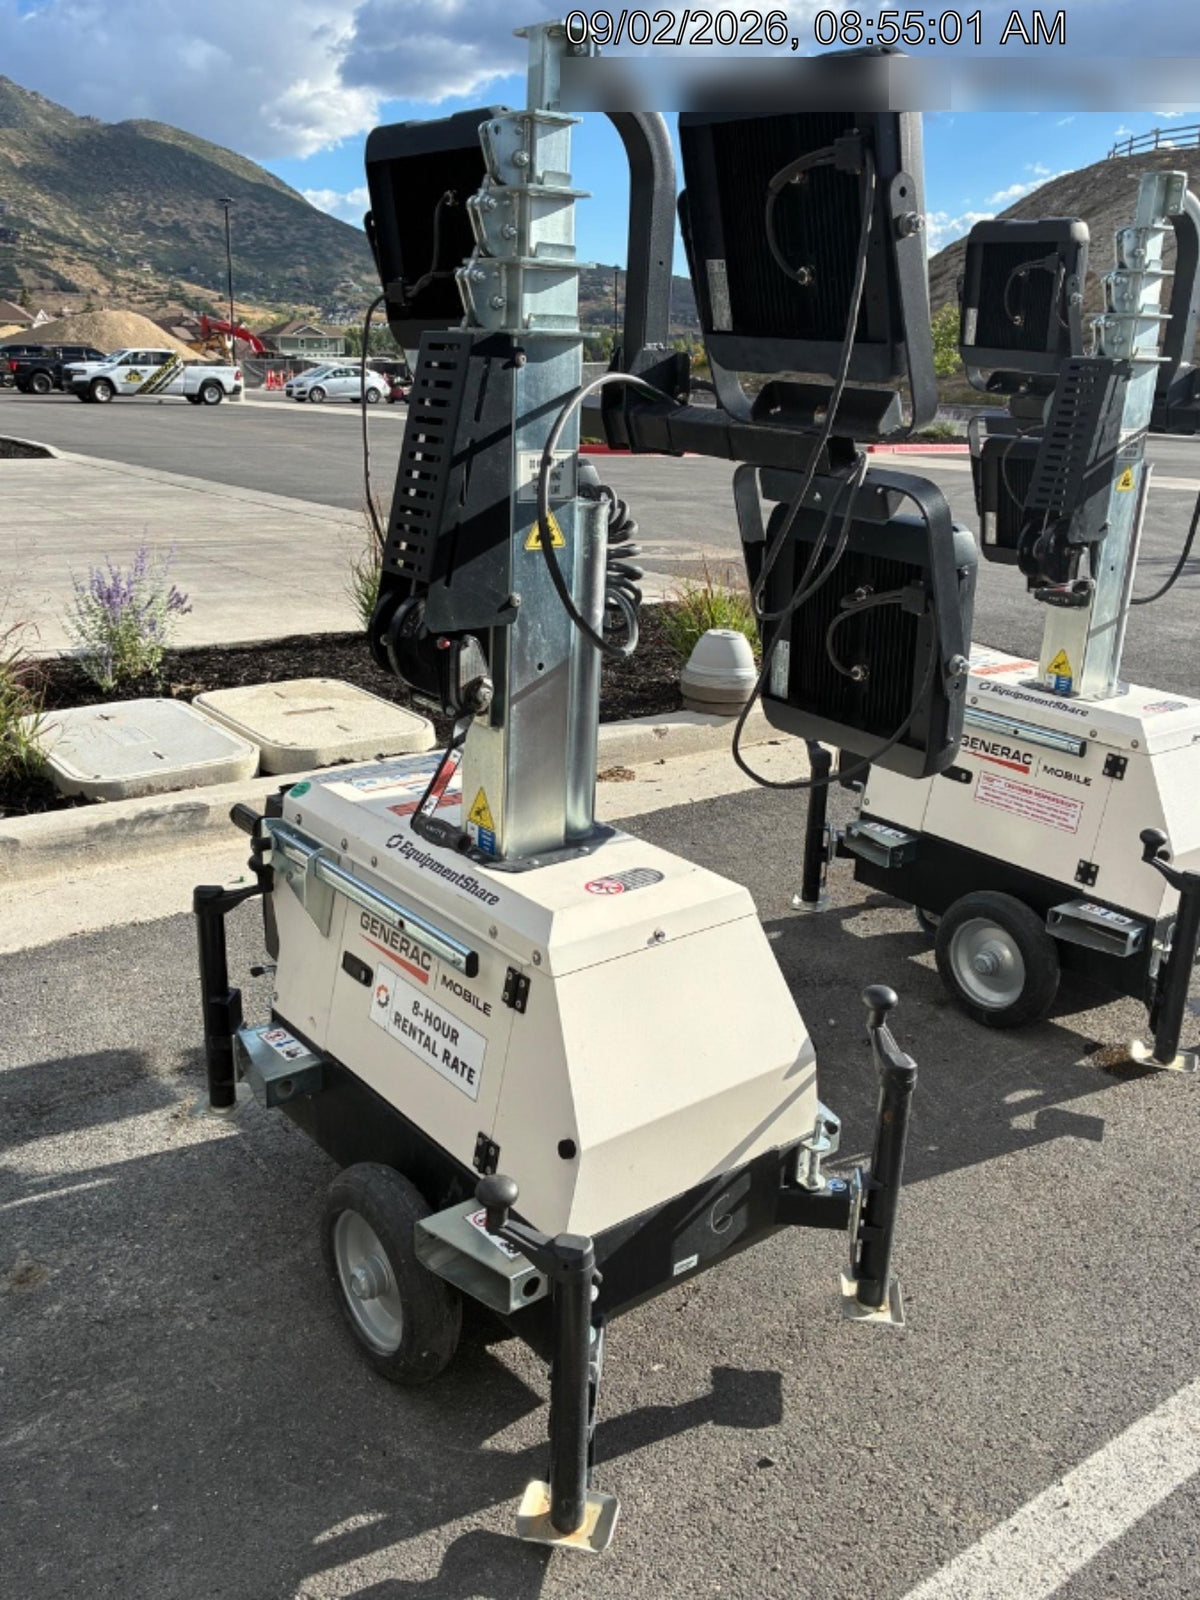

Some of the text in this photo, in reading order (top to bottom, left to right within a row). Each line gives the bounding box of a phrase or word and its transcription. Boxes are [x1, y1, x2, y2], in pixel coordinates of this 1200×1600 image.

[991, 686, 1088, 717] EquipmentShare
[961, 735, 1092, 786] GENERAC MOBILE
[400, 842, 499, 906] EquipmentShare
[360, 912, 493, 1018] GENERAC MOBILE
[393, 1010, 476, 1086] RENTAL RATE
[411, 1000, 460, 1047] 8-HOUR
